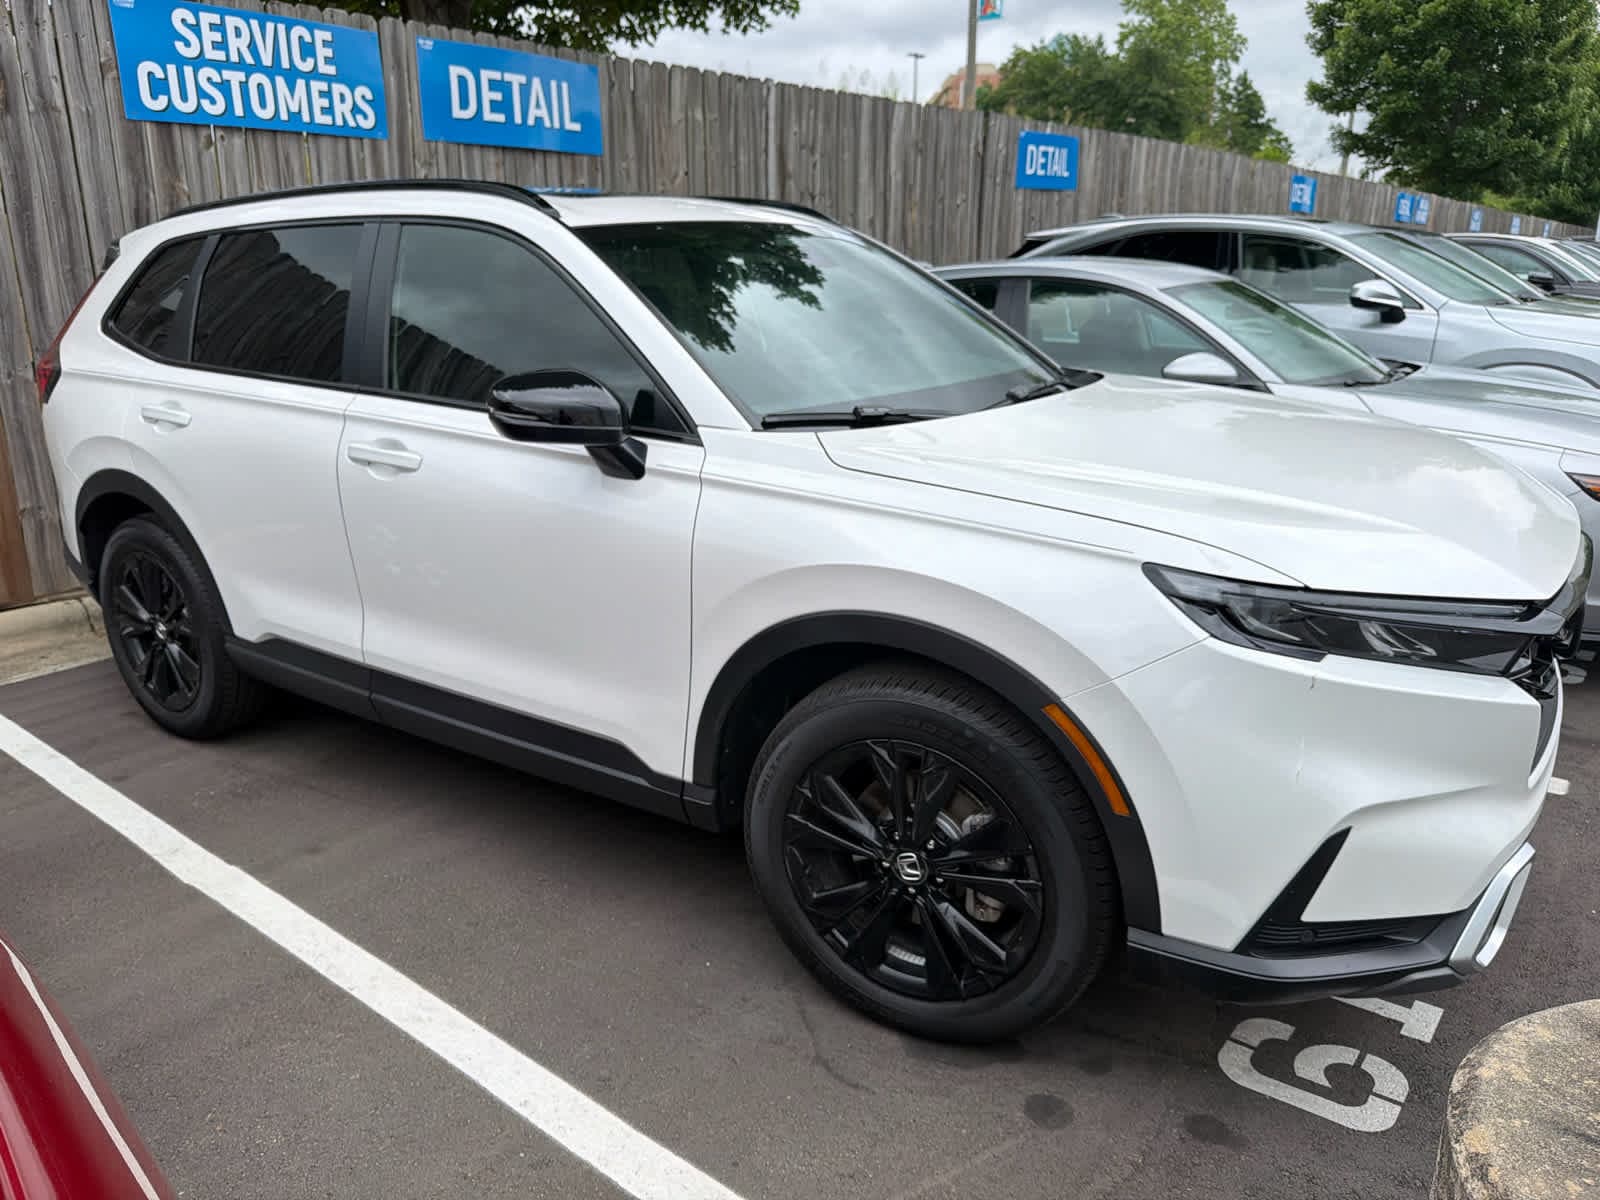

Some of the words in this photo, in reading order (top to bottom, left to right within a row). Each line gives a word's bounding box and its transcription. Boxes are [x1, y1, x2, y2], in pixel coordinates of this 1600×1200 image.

[170, 7, 337, 76] SERVICE
[136, 60, 377, 130] CUSTOMERS
[448, 64, 582, 132] DETAIL
[1025, 143, 1070, 178] DETAIL
